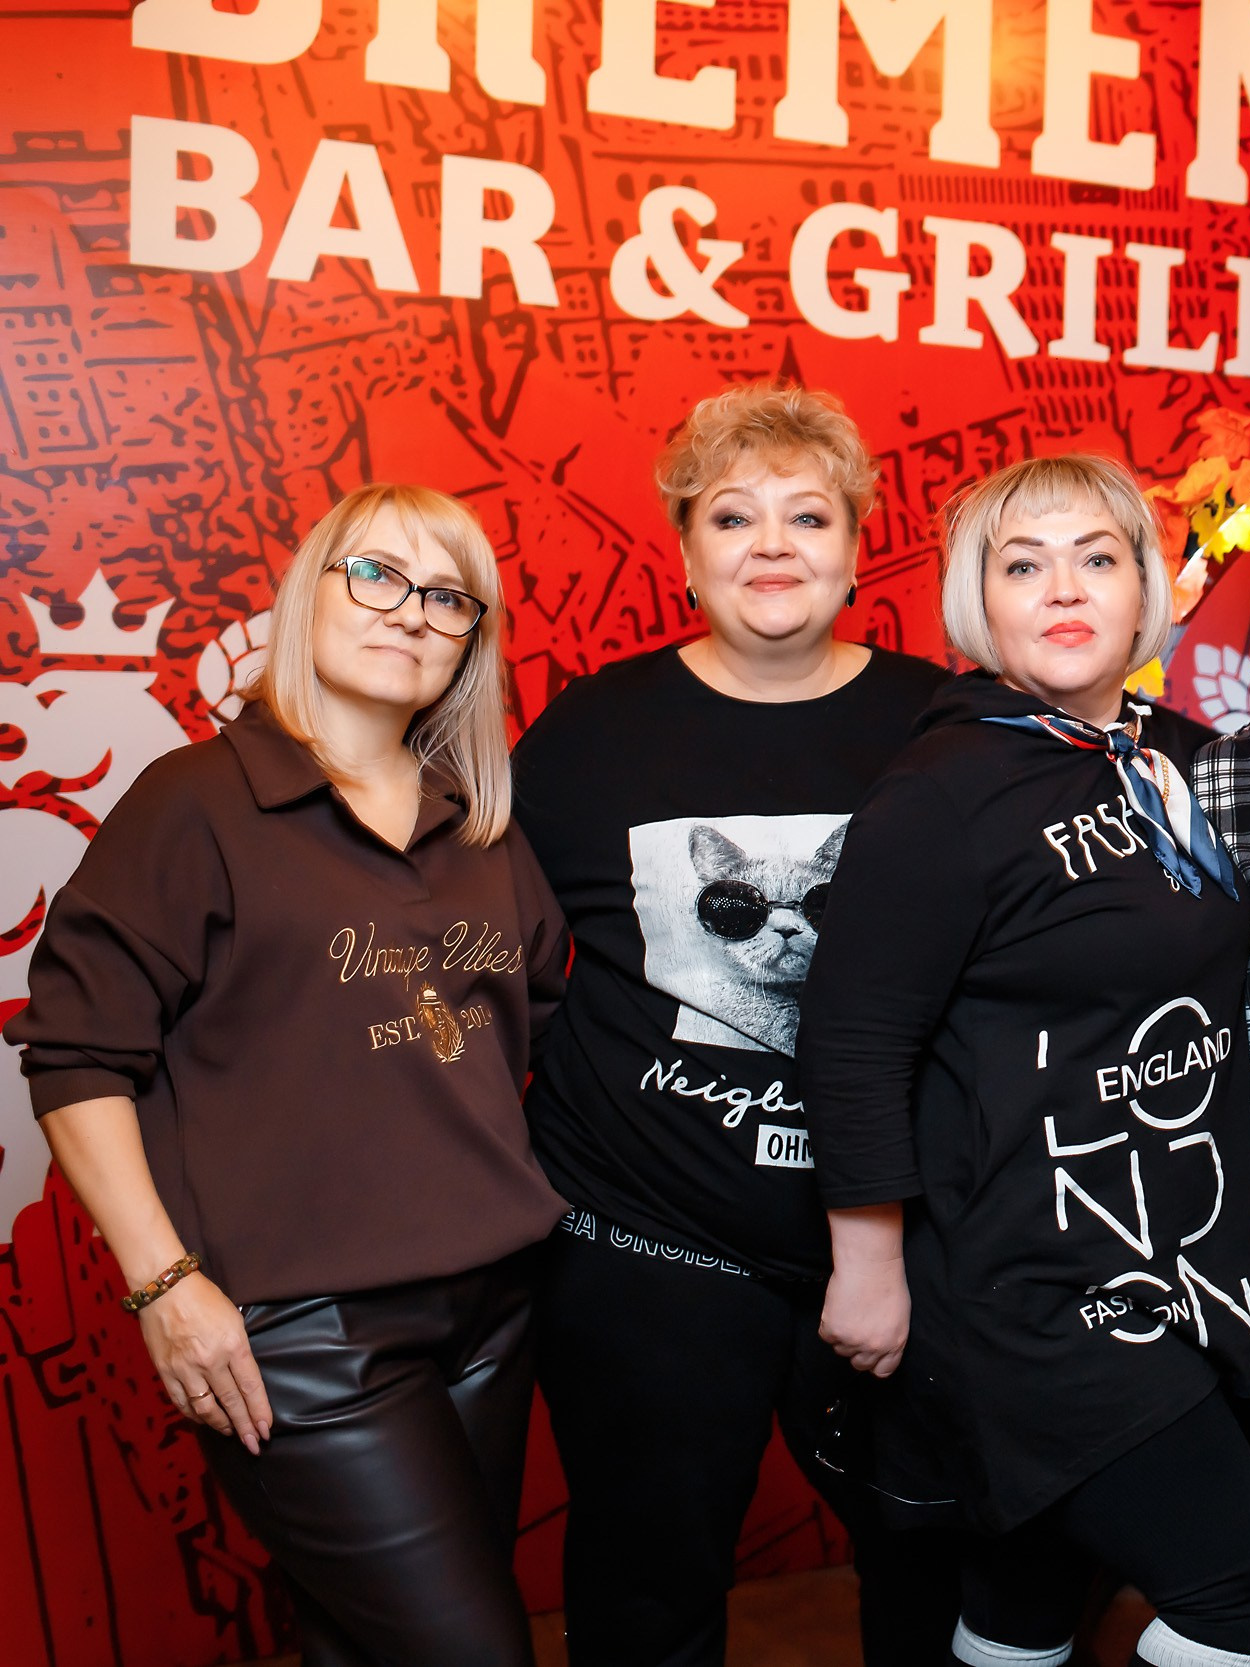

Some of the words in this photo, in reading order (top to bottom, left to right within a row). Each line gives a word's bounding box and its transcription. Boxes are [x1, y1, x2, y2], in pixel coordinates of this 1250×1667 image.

[129, 114, 560, 308] BAR
[609, 185, 750, 328] &
[329, 921, 433, 992] Vintage
[442, 921, 524, 974] Vibes
[460, 1004, 492, 1031] 201
[1097, 1027, 1231, 1102] ENGLAND
